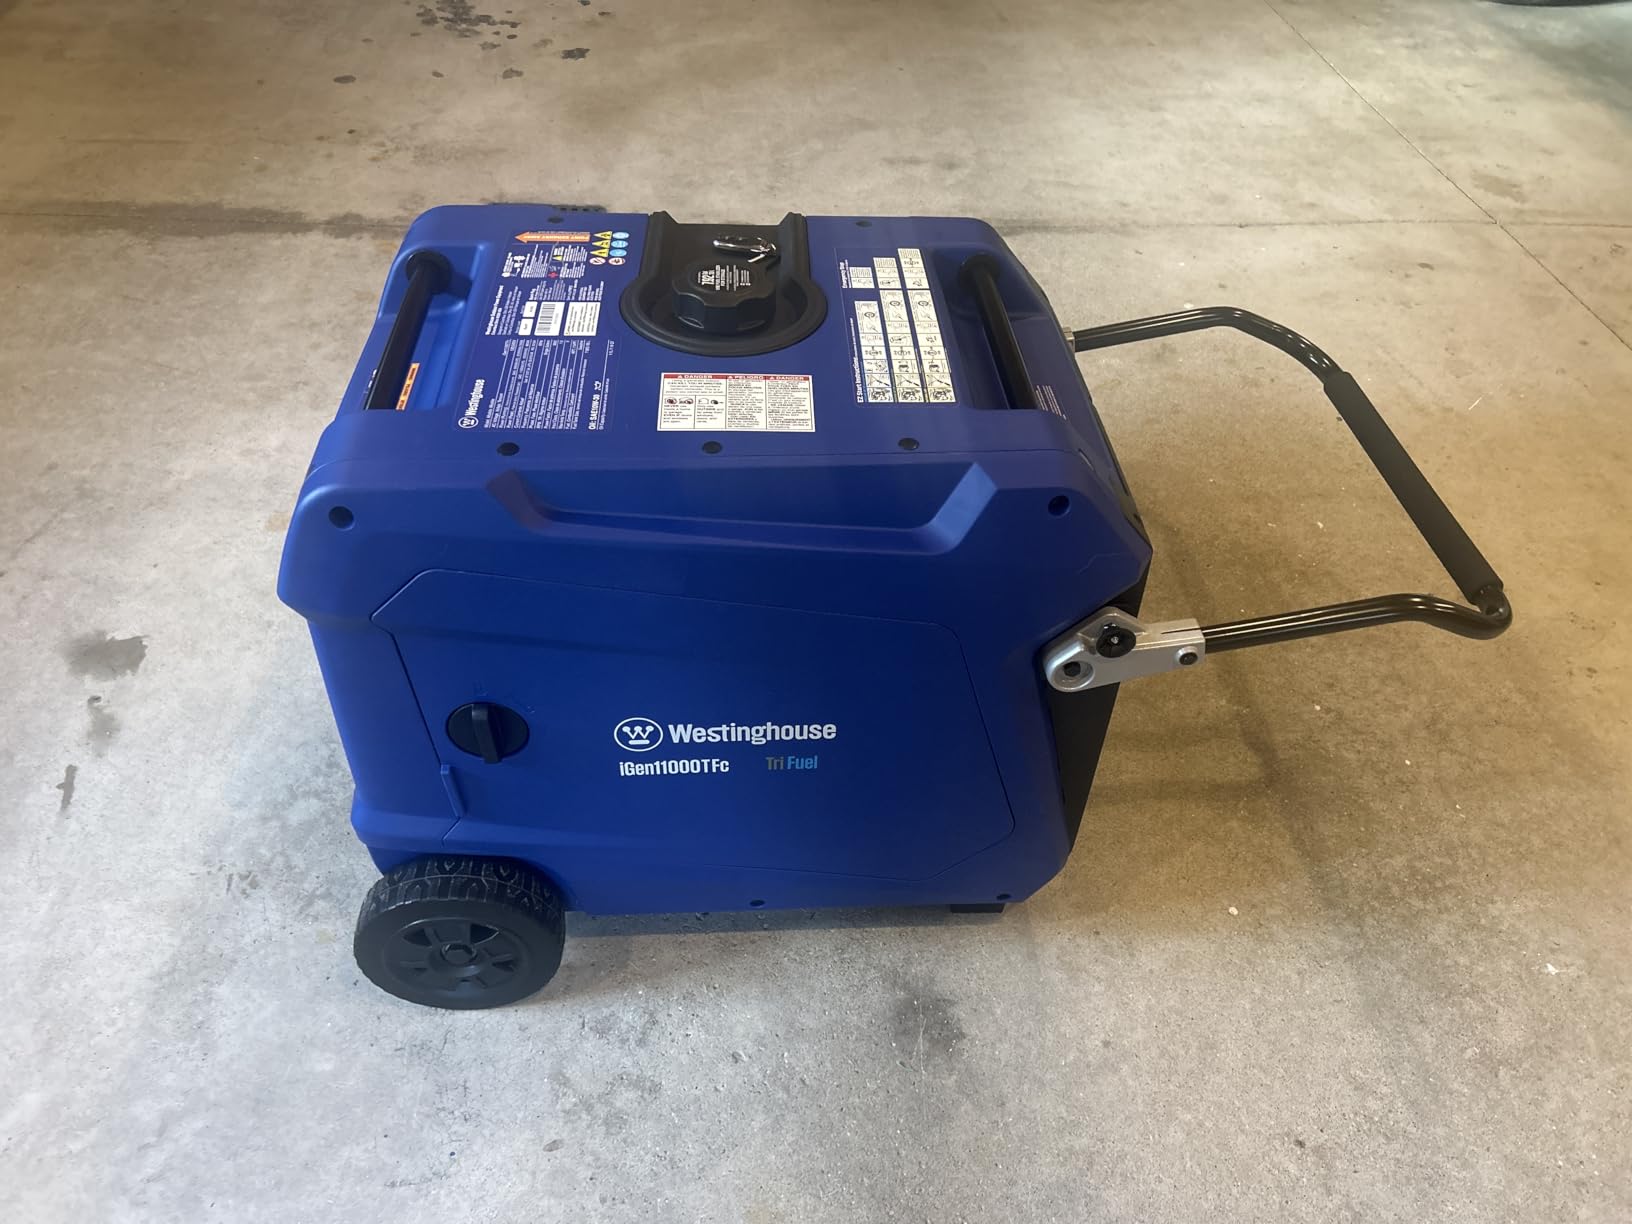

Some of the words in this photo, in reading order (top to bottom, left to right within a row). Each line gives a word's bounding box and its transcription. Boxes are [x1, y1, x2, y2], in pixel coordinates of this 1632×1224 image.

[464, 379, 485, 416] Westinghouse
[668, 722, 837, 745] Westinghouse
[620, 758, 730, 776] iGen11000TFc
[766, 757, 784, 770] Tri
[787, 756, 818, 770] Fuel
